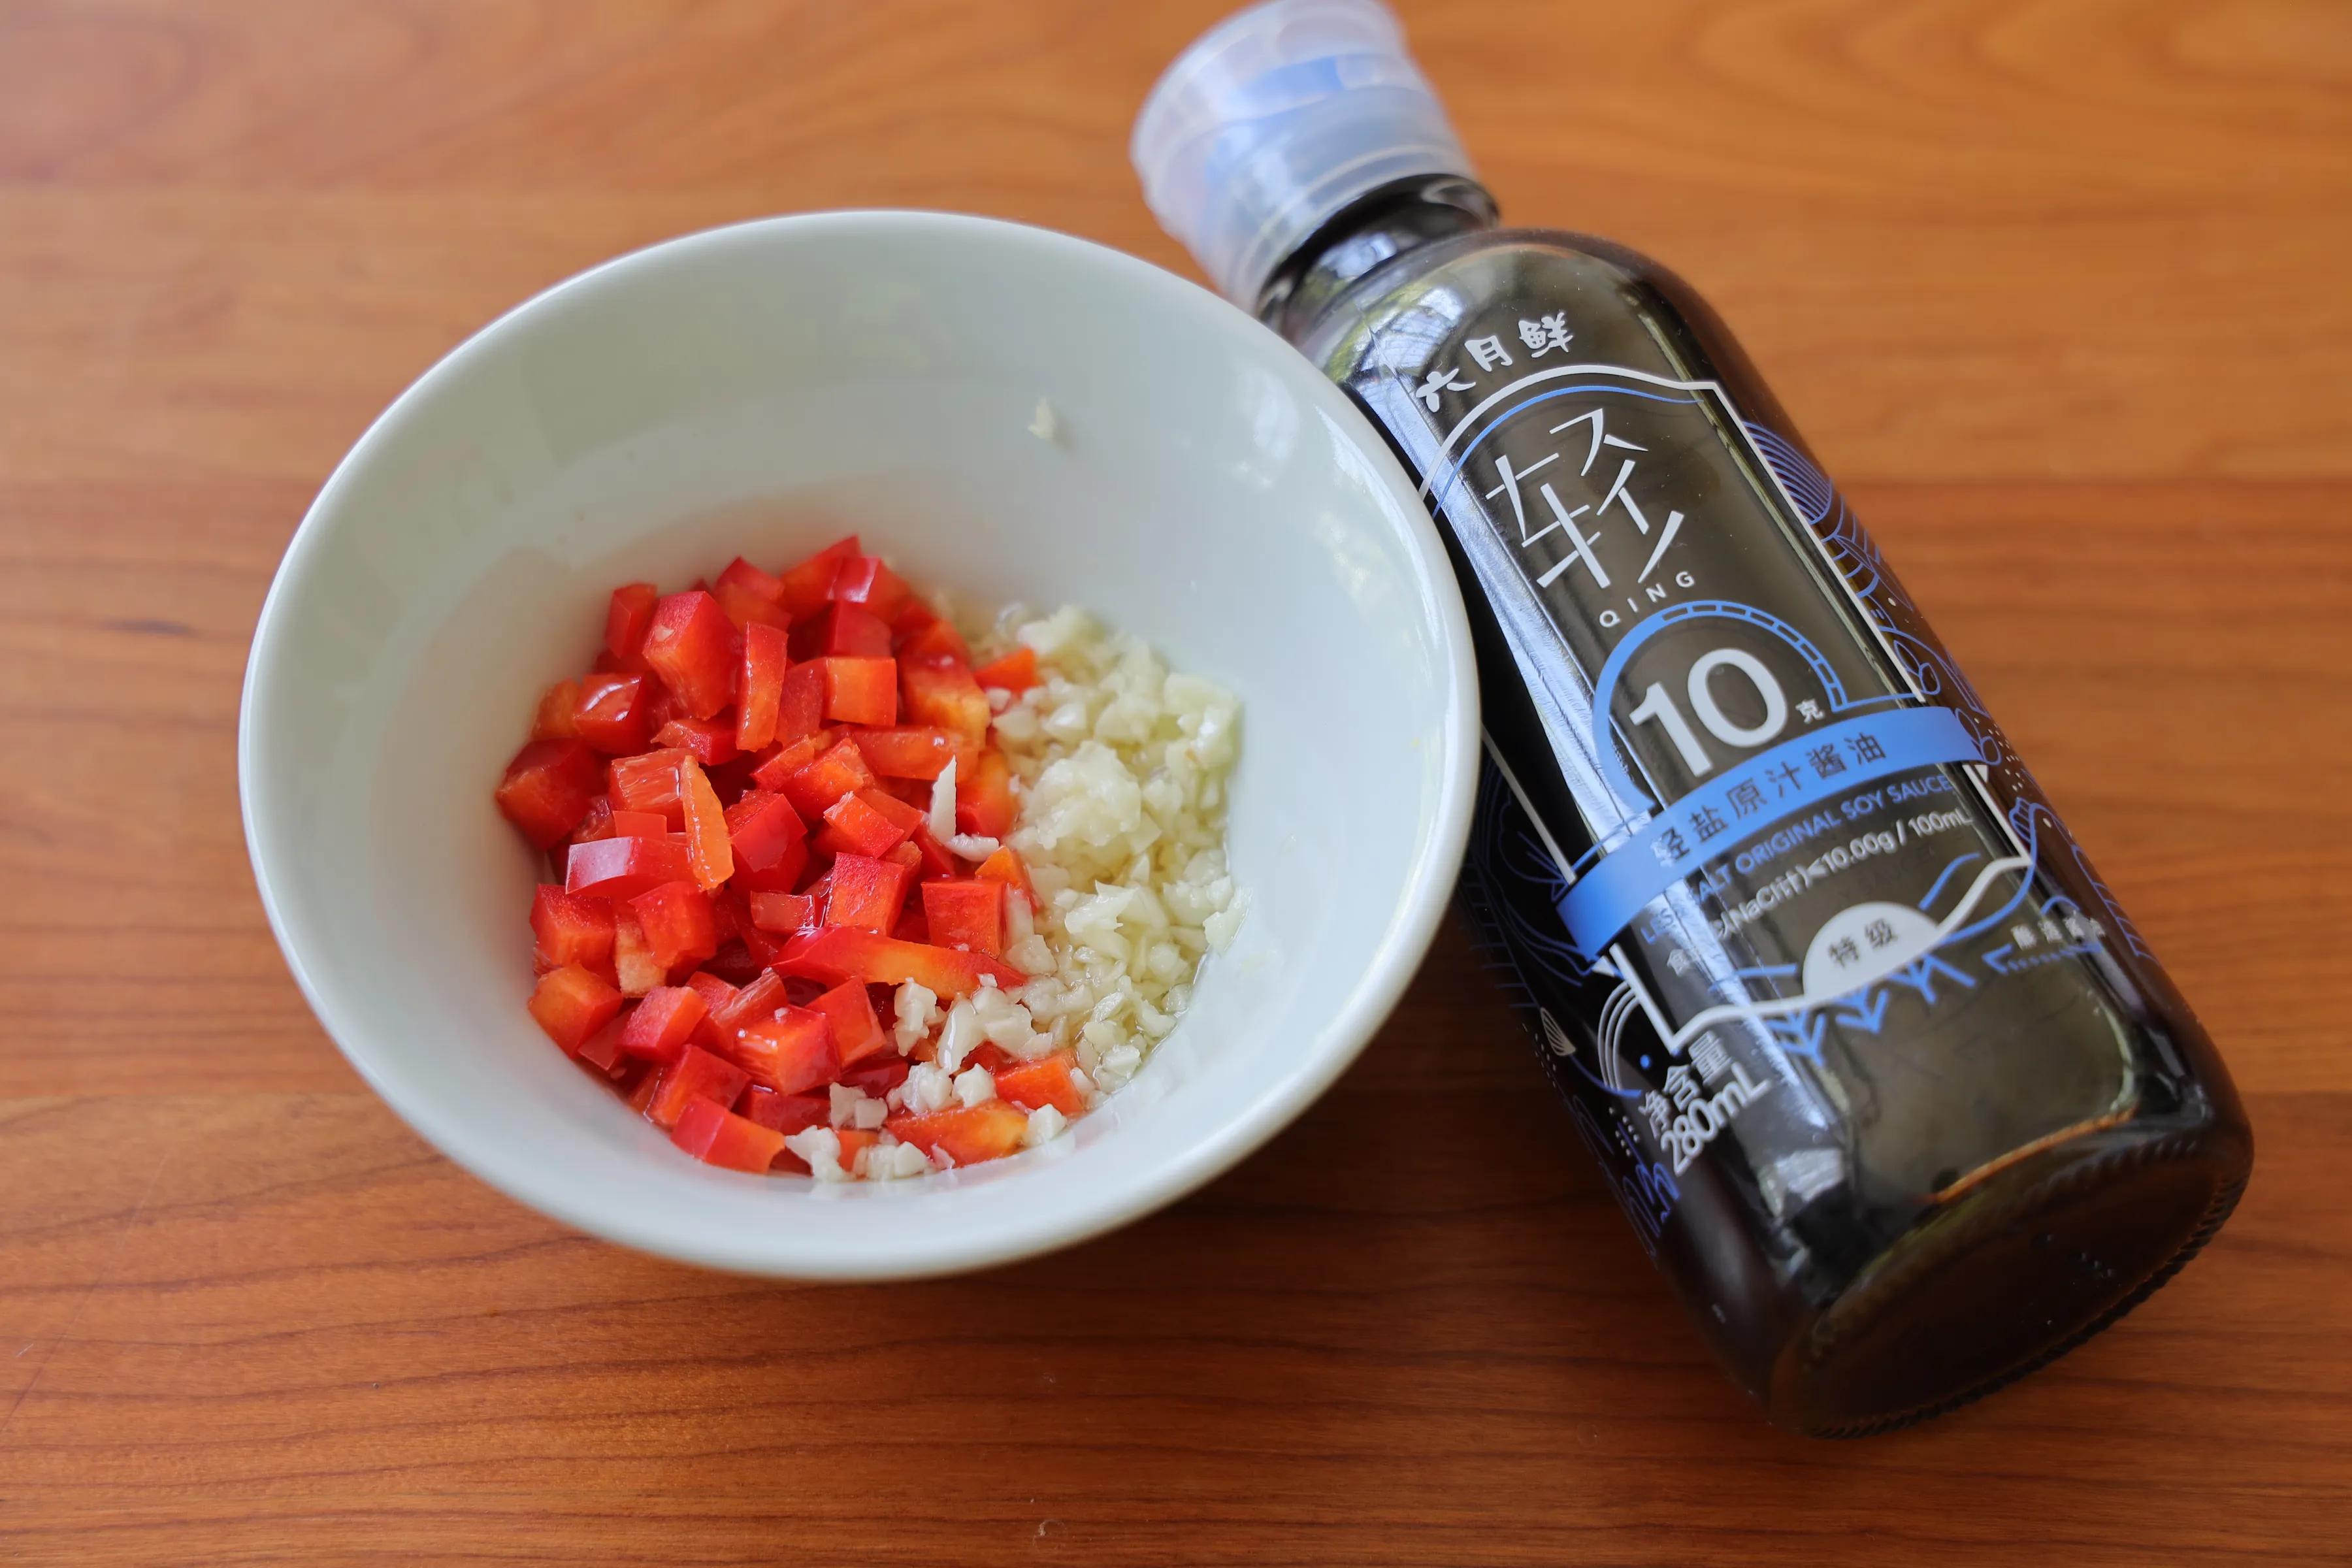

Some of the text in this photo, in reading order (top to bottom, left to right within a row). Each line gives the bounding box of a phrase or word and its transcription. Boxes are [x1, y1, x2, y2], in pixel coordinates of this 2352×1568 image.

[1416, 312, 1573, 412] 六月鲜
[1599, 570, 1695, 628] QING
[1629, 647, 1788, 777] 10
[1641, 900, 1687, 945] LES
[1735, 809, 1842, 875] ORIGINAL
[1840, 789, 1886, 821] SOY
[1887, 774, 1954, 804] SAUCE
[1908, 808, 1974, 839] 100mL
[1638, 1030, 1732, 1141] 净含量
[1660, 1061, 1772, 1177] 280mL
